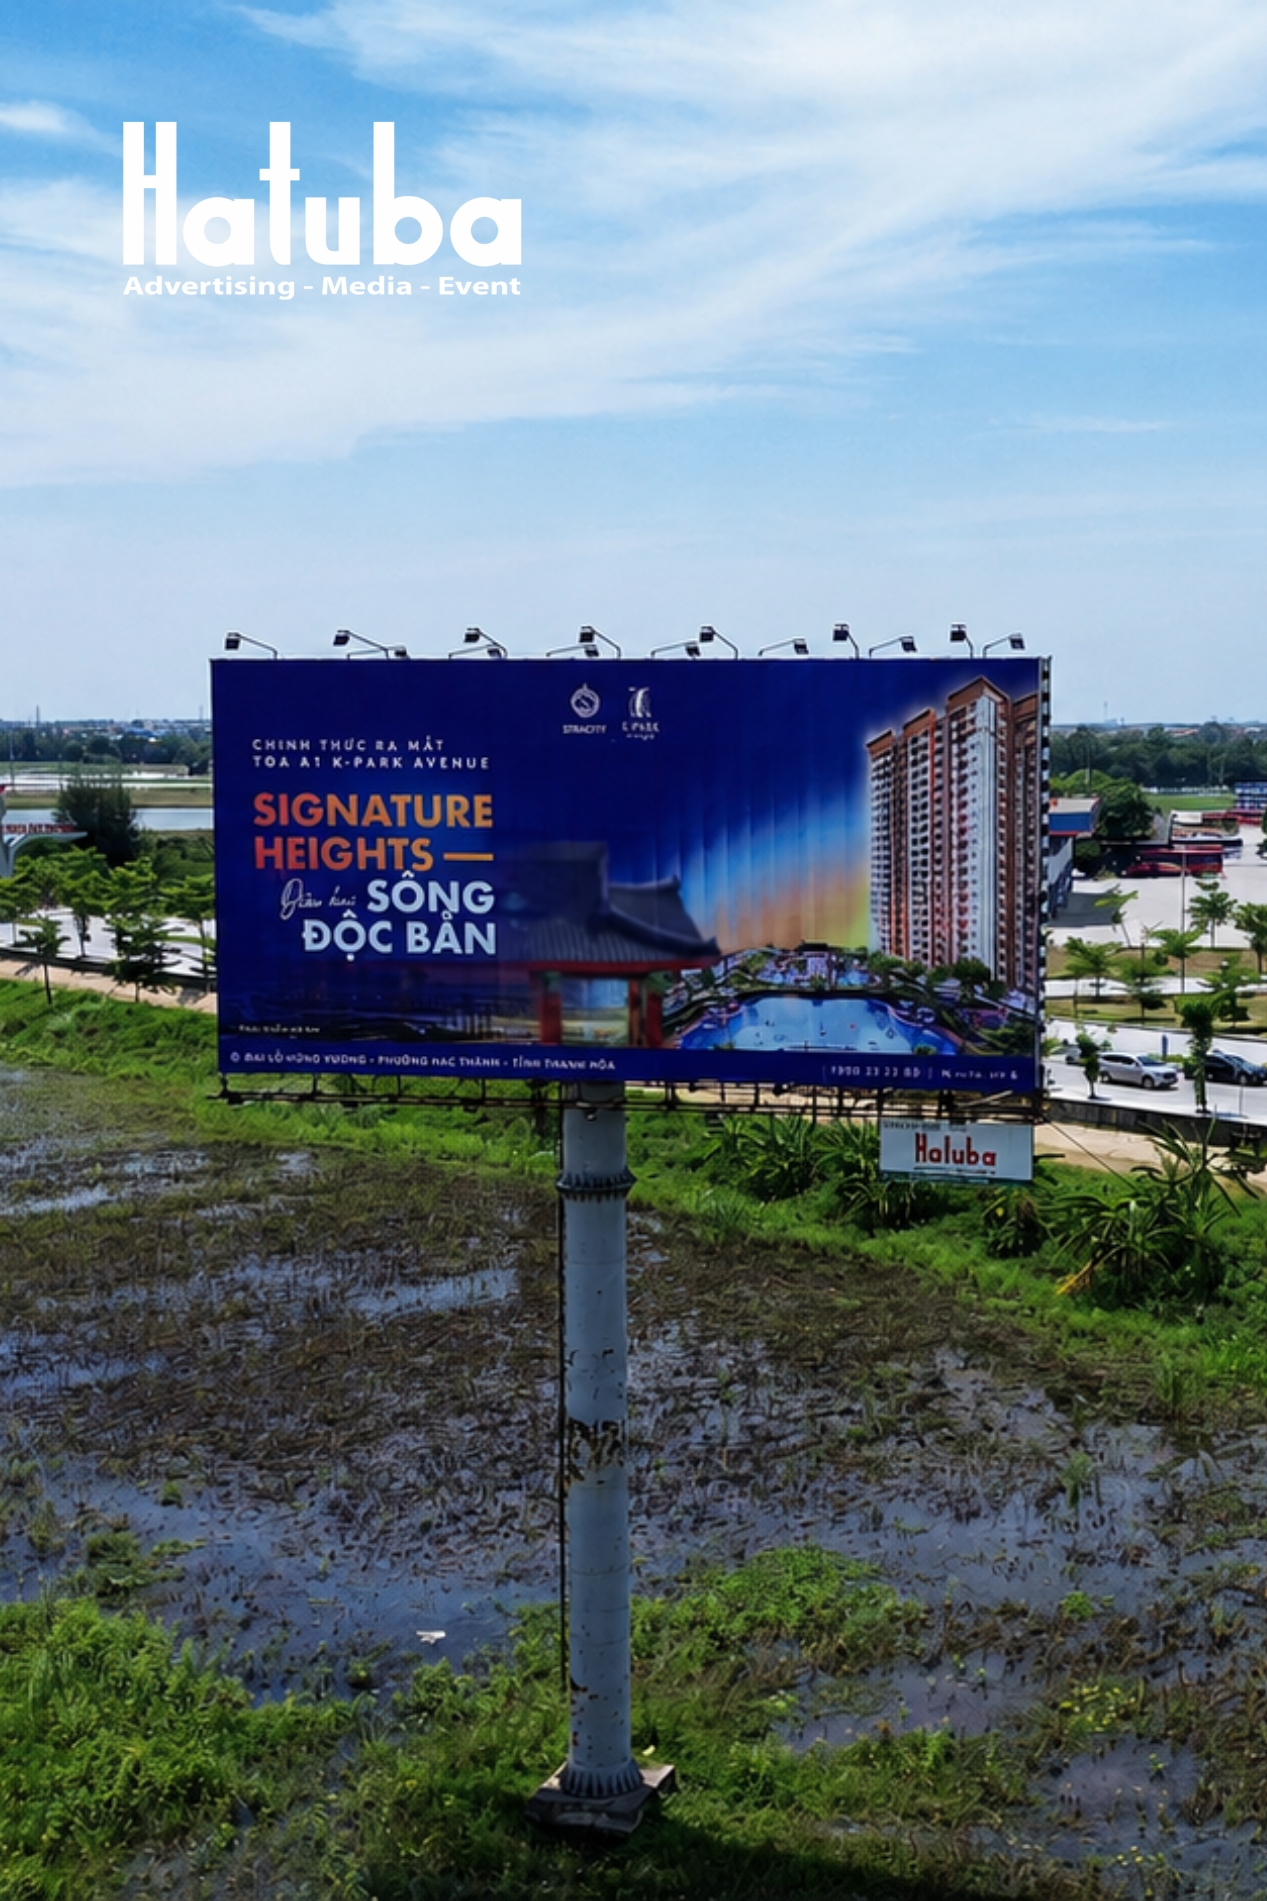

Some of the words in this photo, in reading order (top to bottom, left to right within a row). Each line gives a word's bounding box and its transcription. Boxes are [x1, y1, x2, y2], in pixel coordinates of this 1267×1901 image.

[332, 756, 403, 768] K-PARK
[413, 757, 490, 769] AVENUE
[375, 740, 398, 751] RA
[253, 793, 493, 828] SIGNATURE
[254, 837, 434, 871] HEIGHTS
[302, 910, 393, 962] ĐỘC
